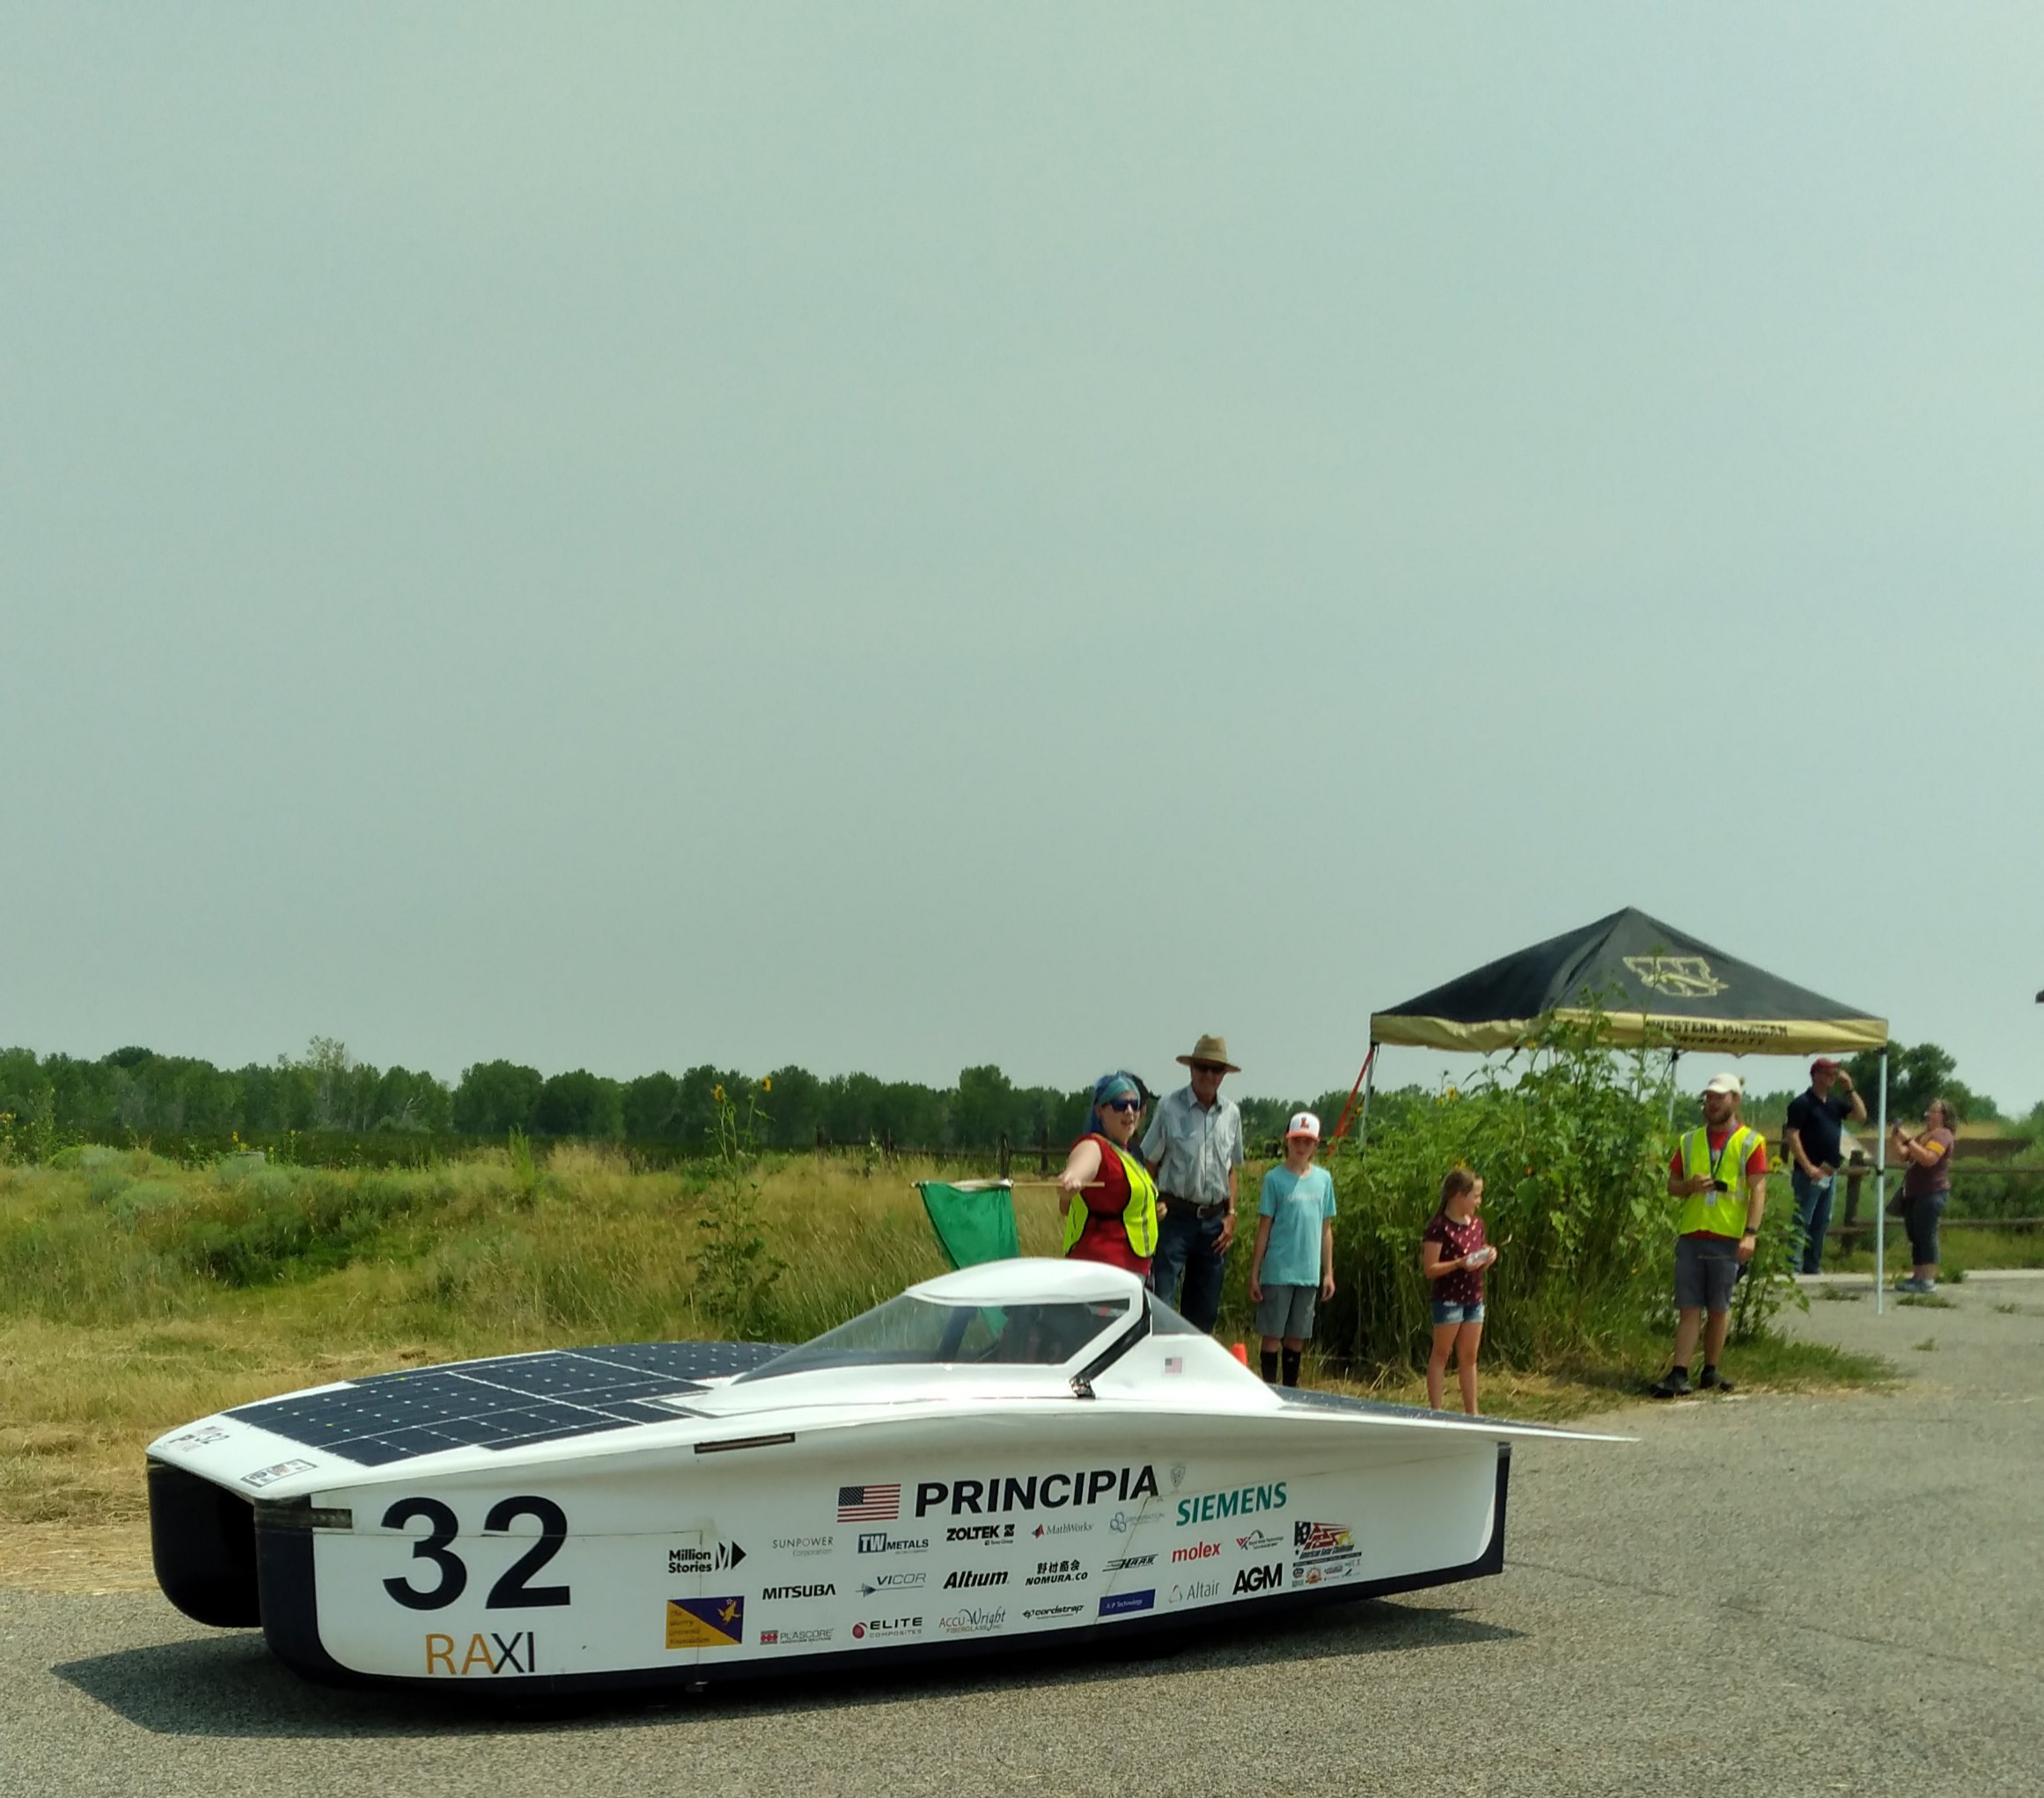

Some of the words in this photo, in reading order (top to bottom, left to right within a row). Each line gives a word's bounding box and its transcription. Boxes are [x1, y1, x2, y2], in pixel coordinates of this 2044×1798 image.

[1300, 1117, 1309, 1128] L
[915, 1465, 1158, 1517] PRINCIPIA
[1176, 1482, 1287, 1526] SIEMENS
[946, 1524, 1000, 1542] ZOLTEK
[1047, 1522, 1092, 1536] MathWorks
[772, 1537, 833, 1549] SUNPOWER
[380, 1495, 570, 1611] 32
[669, 1549, 711, 1561] Million
[1172, 1541, 1221, 1563] molex
[668, 1560, 712, 1574] Stories
[877, 1573, 927, 1586] VICOR
[943, 1570, 1009, 1589] Altium
[1026, 1572, 1088, 1586] NOMURA.CO
[1232, 1563, 1283, 1596] AGM
[762, 1583, 836, 1600] MITSUBA
[1187, 1580, 1220, 1600] Altair
[870, 1617, 923, 1631] ELITE
[780, 1630, 832, 1640] PLASCORE
[870, 1628, 923, 1638] COMPOSITES
